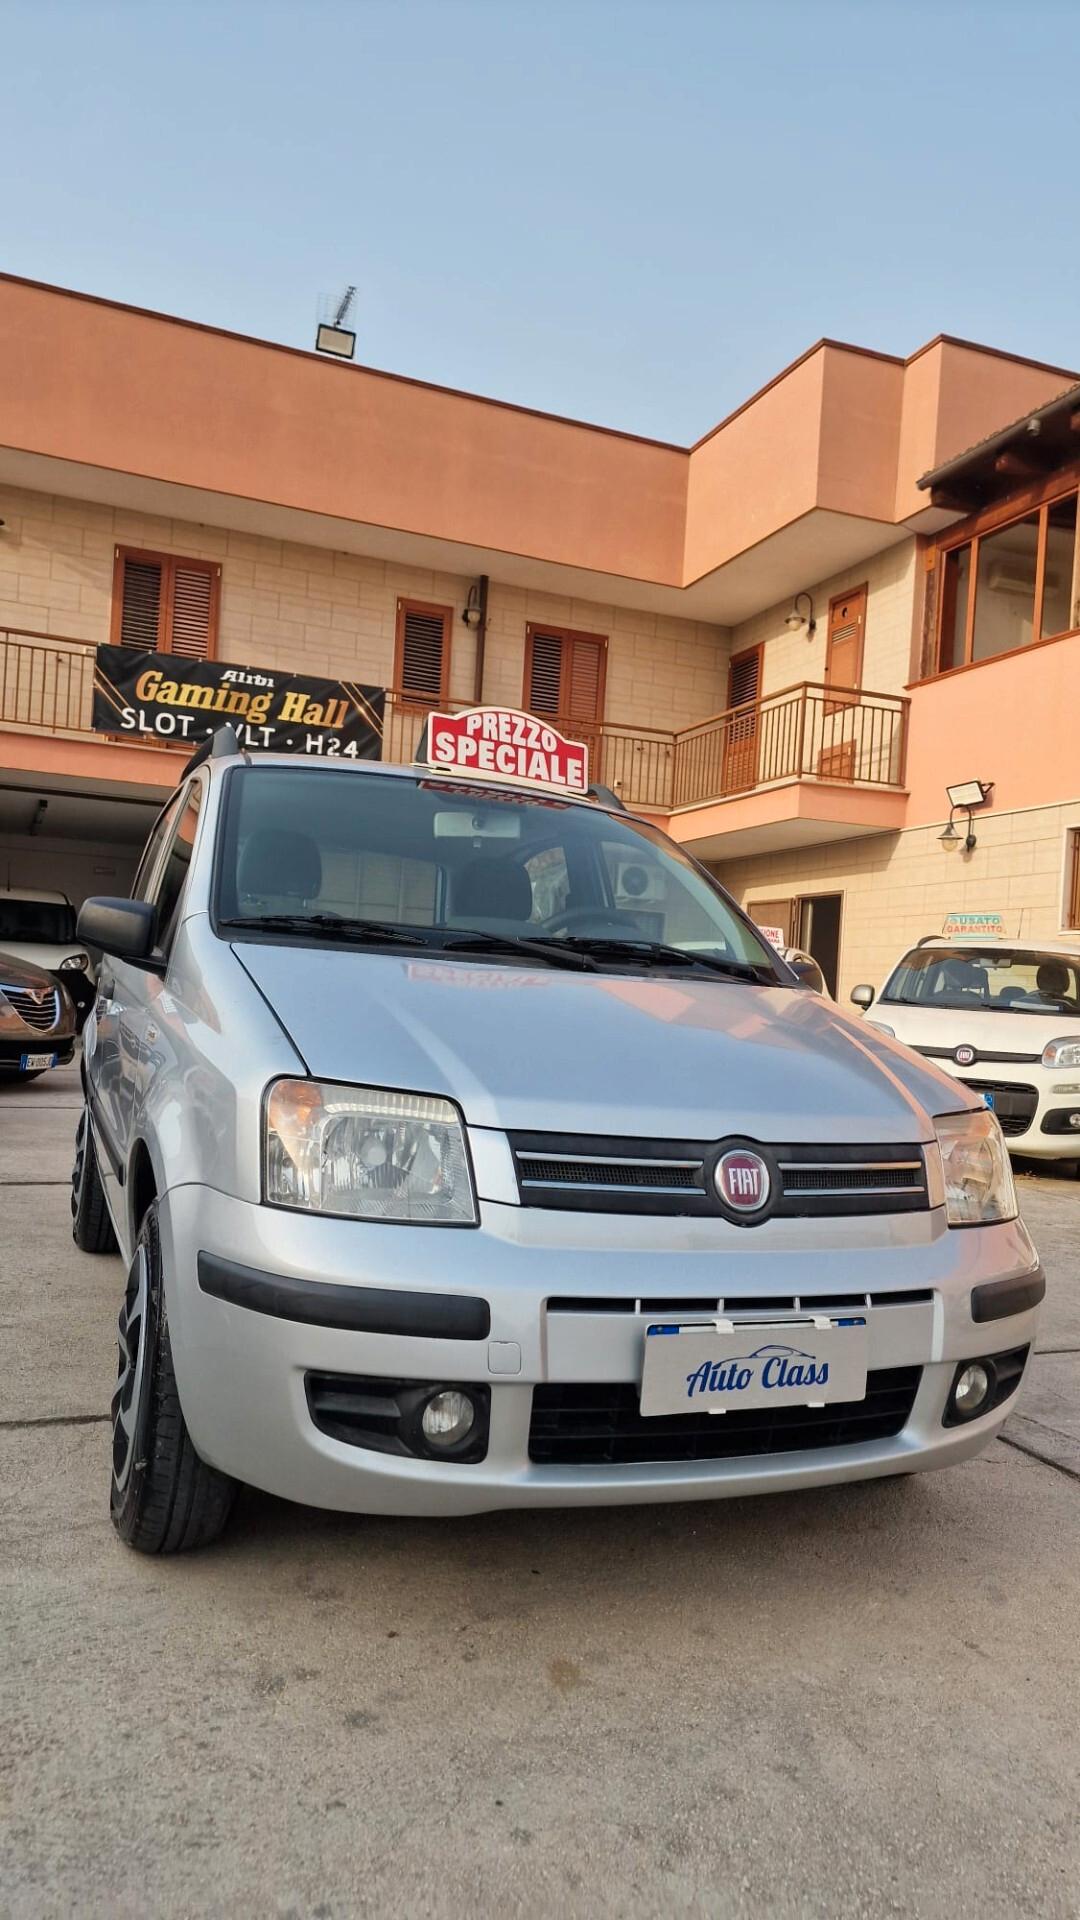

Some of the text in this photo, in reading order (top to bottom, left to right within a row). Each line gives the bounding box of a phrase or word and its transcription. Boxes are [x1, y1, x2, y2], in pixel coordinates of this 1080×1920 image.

[136, 670, 349, 729] Gaming Hall
[120, 707, 195, 737] SLOT
[306, 733, 359, 760] H24
[466, 712, 558, 753] PREZZO
[435, 731, 582, 788] SPECIALE
[728, 1167, 759, 1195] FIAT
[686, 1356, 829, 1398] Auto Class
